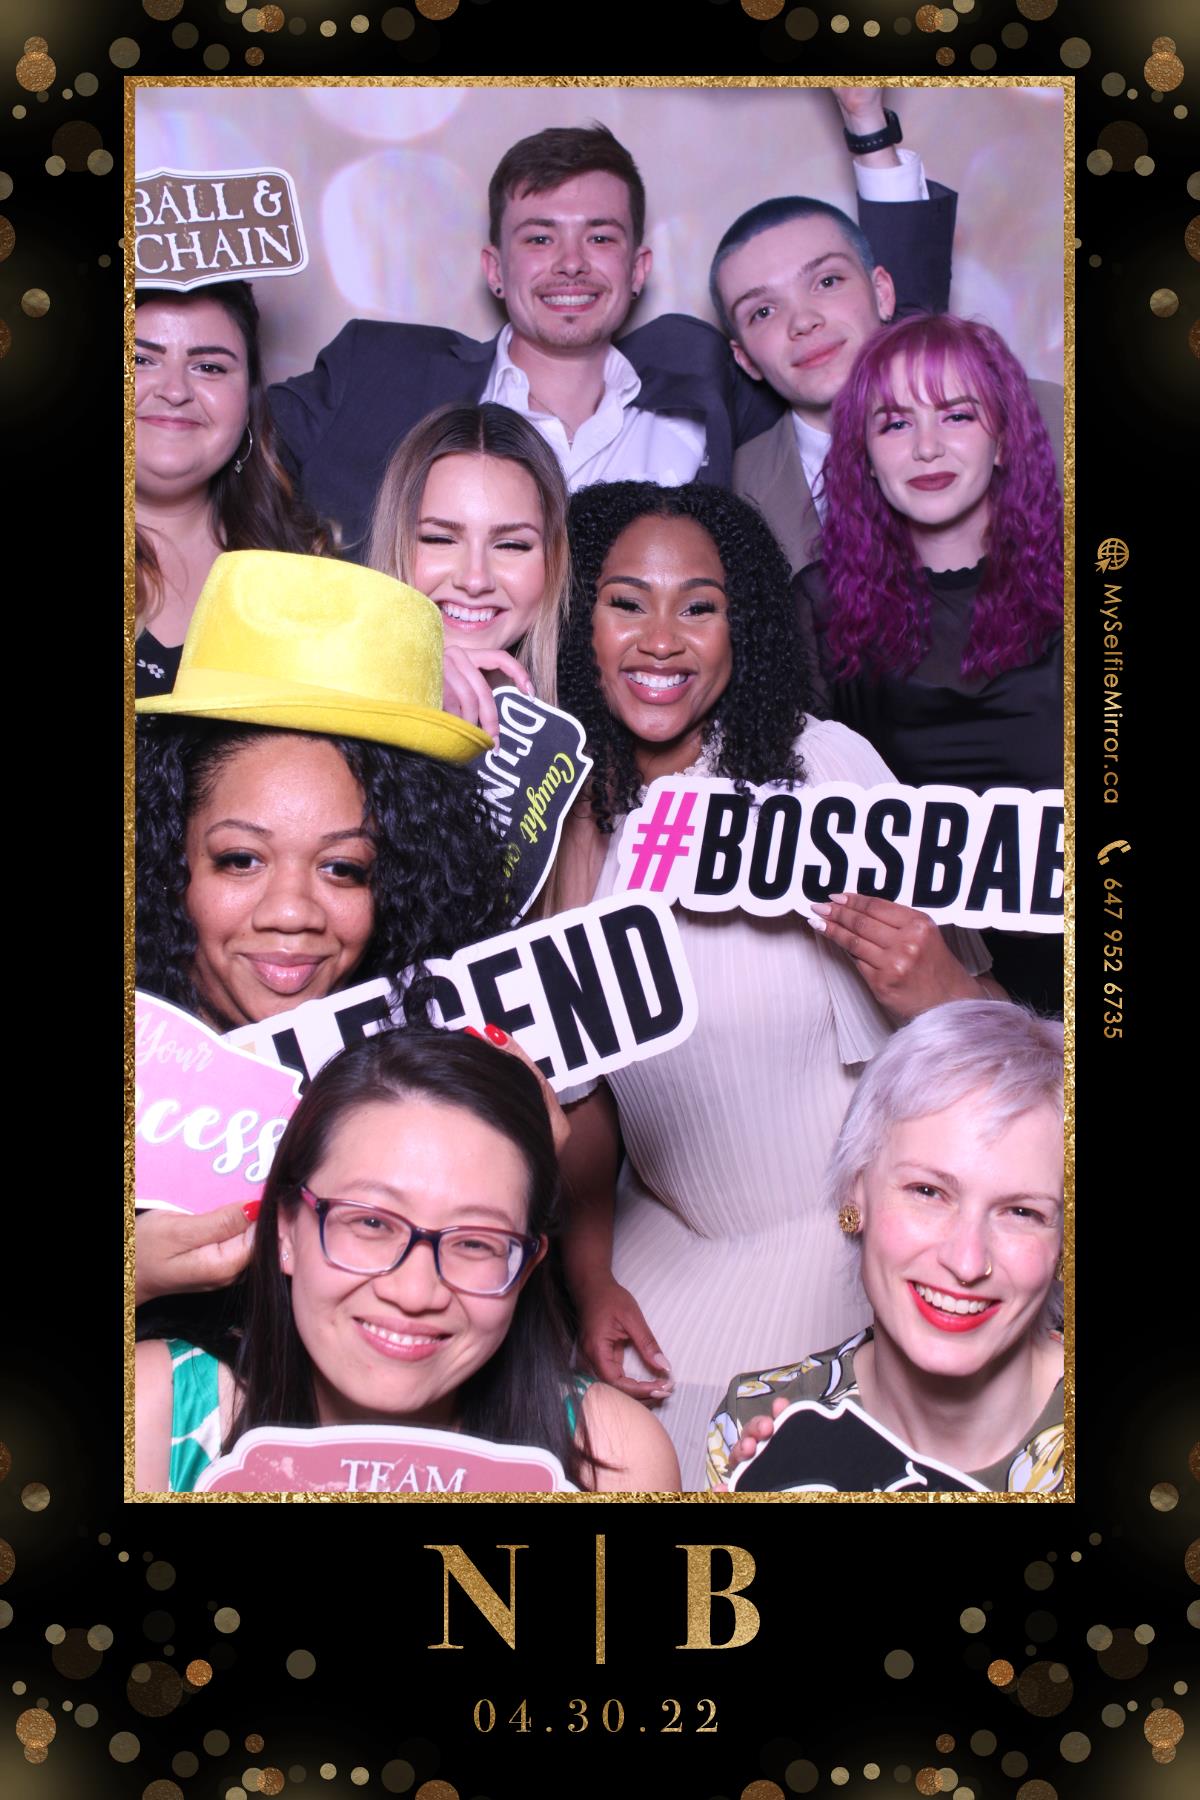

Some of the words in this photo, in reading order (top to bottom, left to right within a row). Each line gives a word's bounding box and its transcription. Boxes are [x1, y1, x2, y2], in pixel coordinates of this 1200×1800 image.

[135, 183, 245, 227] BALL
[253, 179, 282, 217] &
[135, 225, 293, 273] CHAIN
[520, 752, 575, 844] Caught
[135, 1012, 213, 1072] Your
[135, 1084, 289, 1182] cess
[340, 1458, 467, 1492] TEAM
